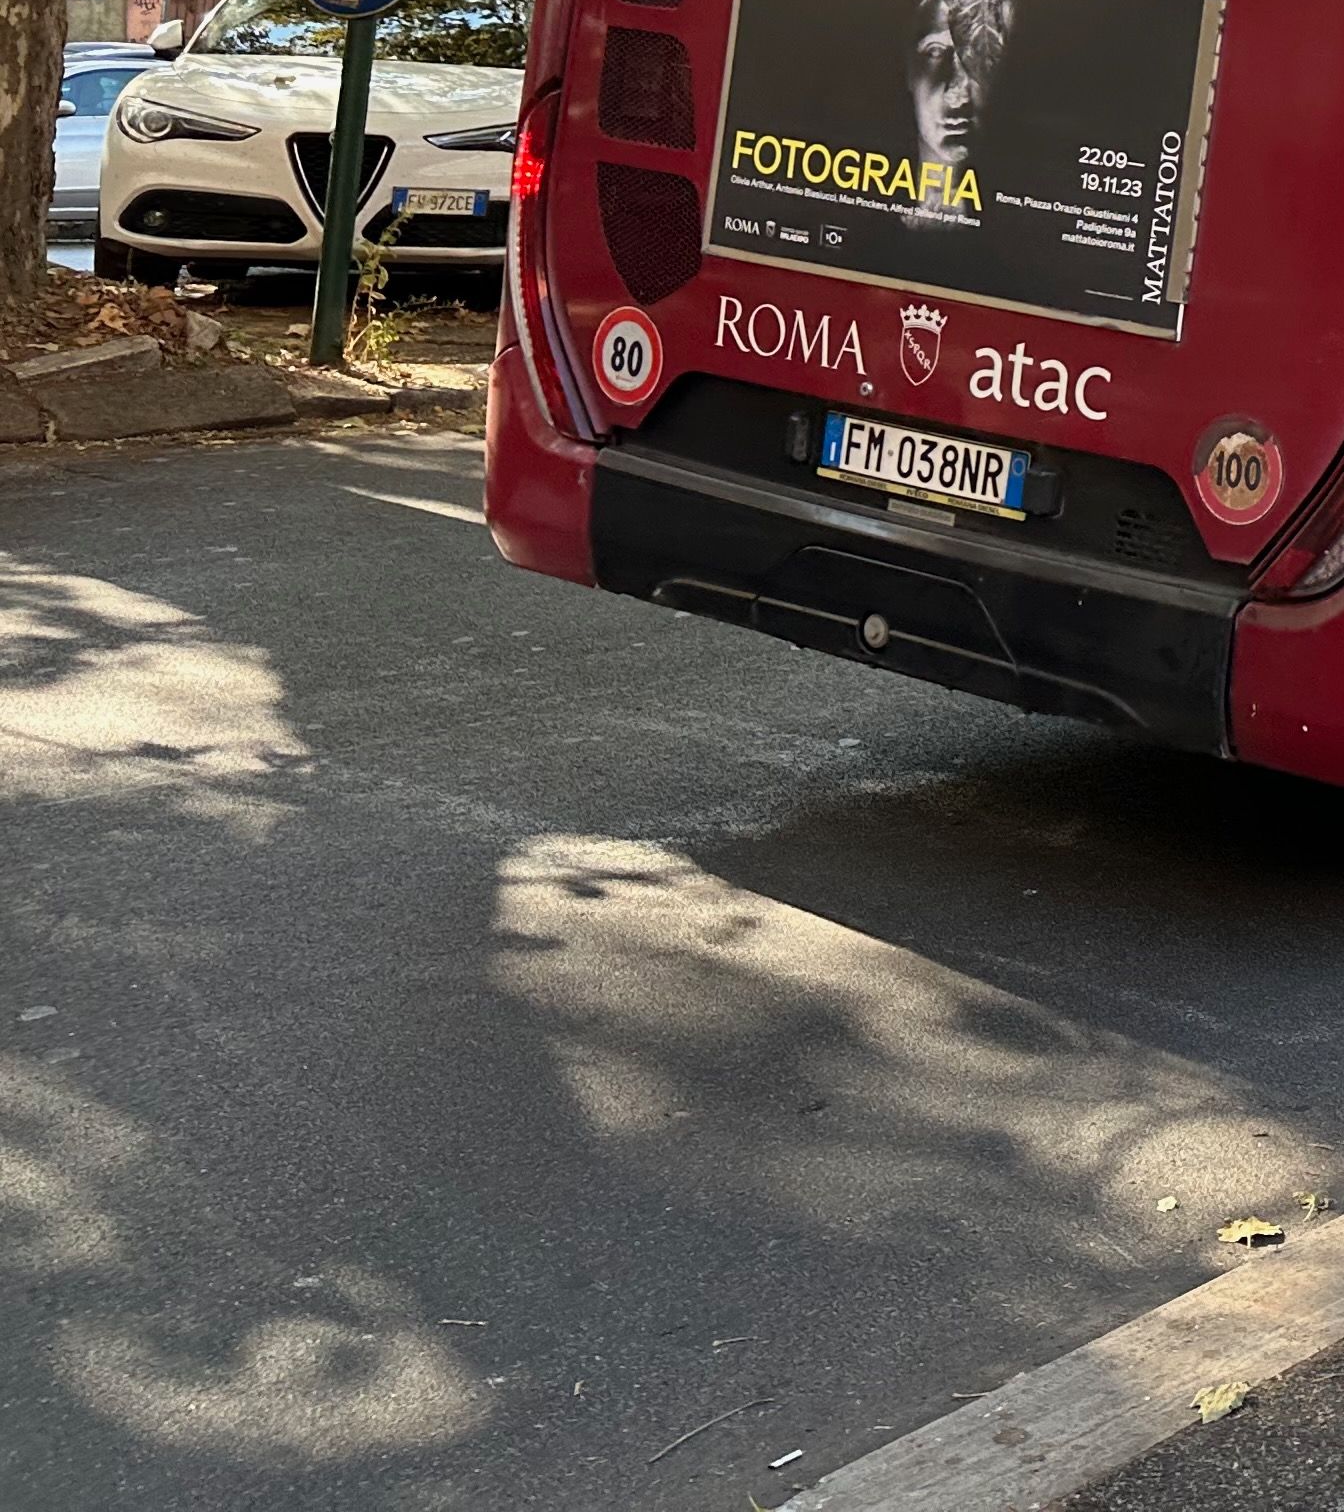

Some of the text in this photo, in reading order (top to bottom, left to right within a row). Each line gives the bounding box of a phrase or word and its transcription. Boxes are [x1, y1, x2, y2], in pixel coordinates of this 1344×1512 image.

[732, 131, 983, 211] FOTOGRAFIA
[1081, 172, 1142, 197] 19.11.23
[776, 183, 804, 196] Antonio
[839, 194, 854, 205] Max
[958, 214, 981, 227] Roma
[996, 192, 1023, 206] Roma,
[1024, 196, 1052, 210] Piazza
[1053, 202, 1082, 215] Orazio
[1132, 214, 1139, 224] 4
[1142, 131, 1181, 306] MATTATOIO
[725, 216, 761, 236] ROMA
[1061, 233, 1135, 252] mattatoioroma.it
[1076, 220, 1137, 238] Padiglione 9a
[714, 295, 867, 376] ROMA
[908, 337, 931, 370] SPQR
[611, 336, 643, 377] 80
[969, 342, 1111, 421] atac
[1216, 451, 1261, 491] 100
[906, 487, 929, 499] IVECO
